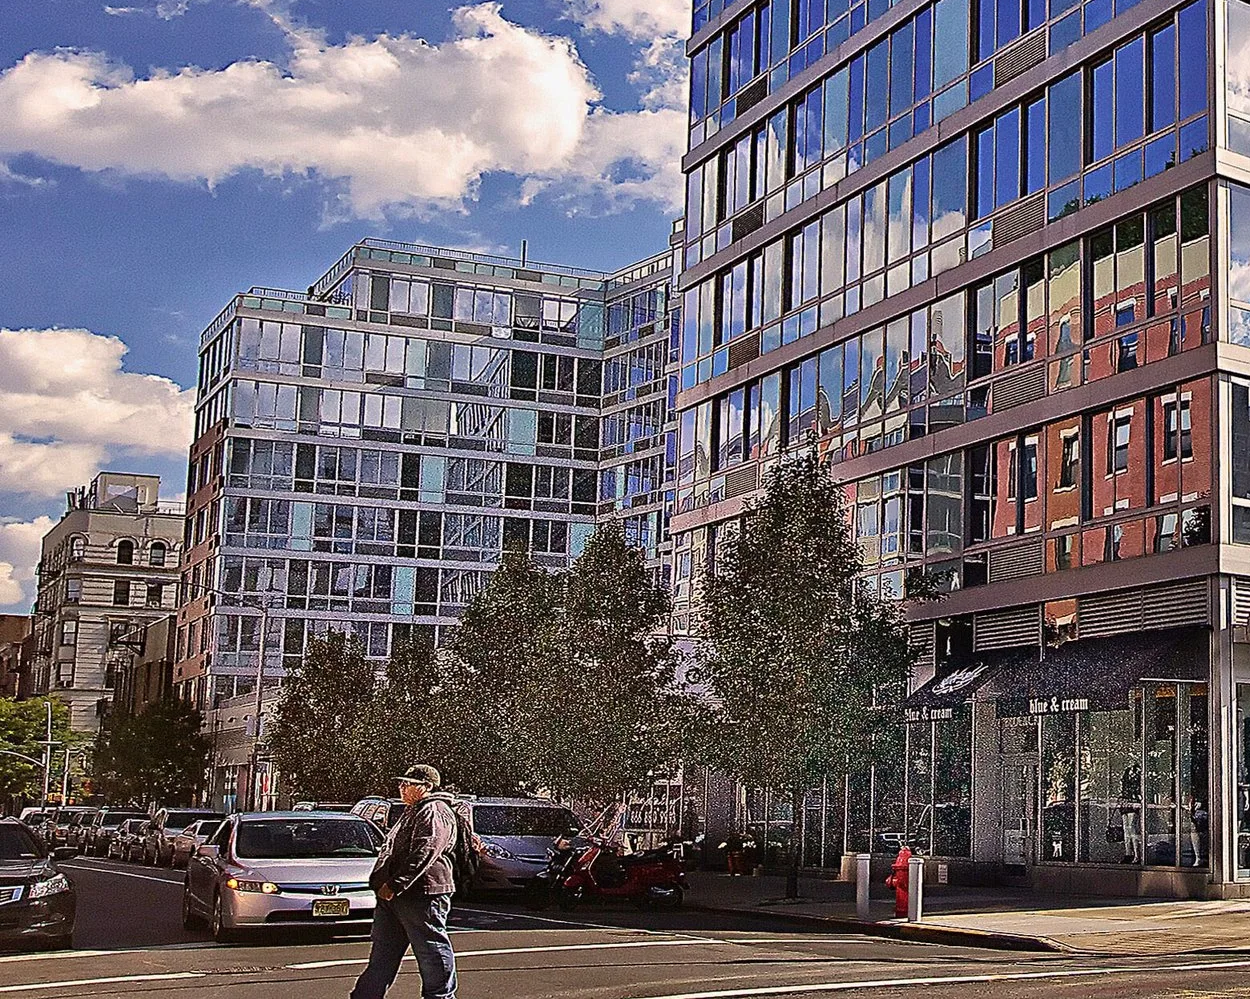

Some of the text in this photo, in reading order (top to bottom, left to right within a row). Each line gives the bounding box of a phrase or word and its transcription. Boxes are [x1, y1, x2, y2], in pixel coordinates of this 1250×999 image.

[1029, 696, 1089, 714] blue & cream
